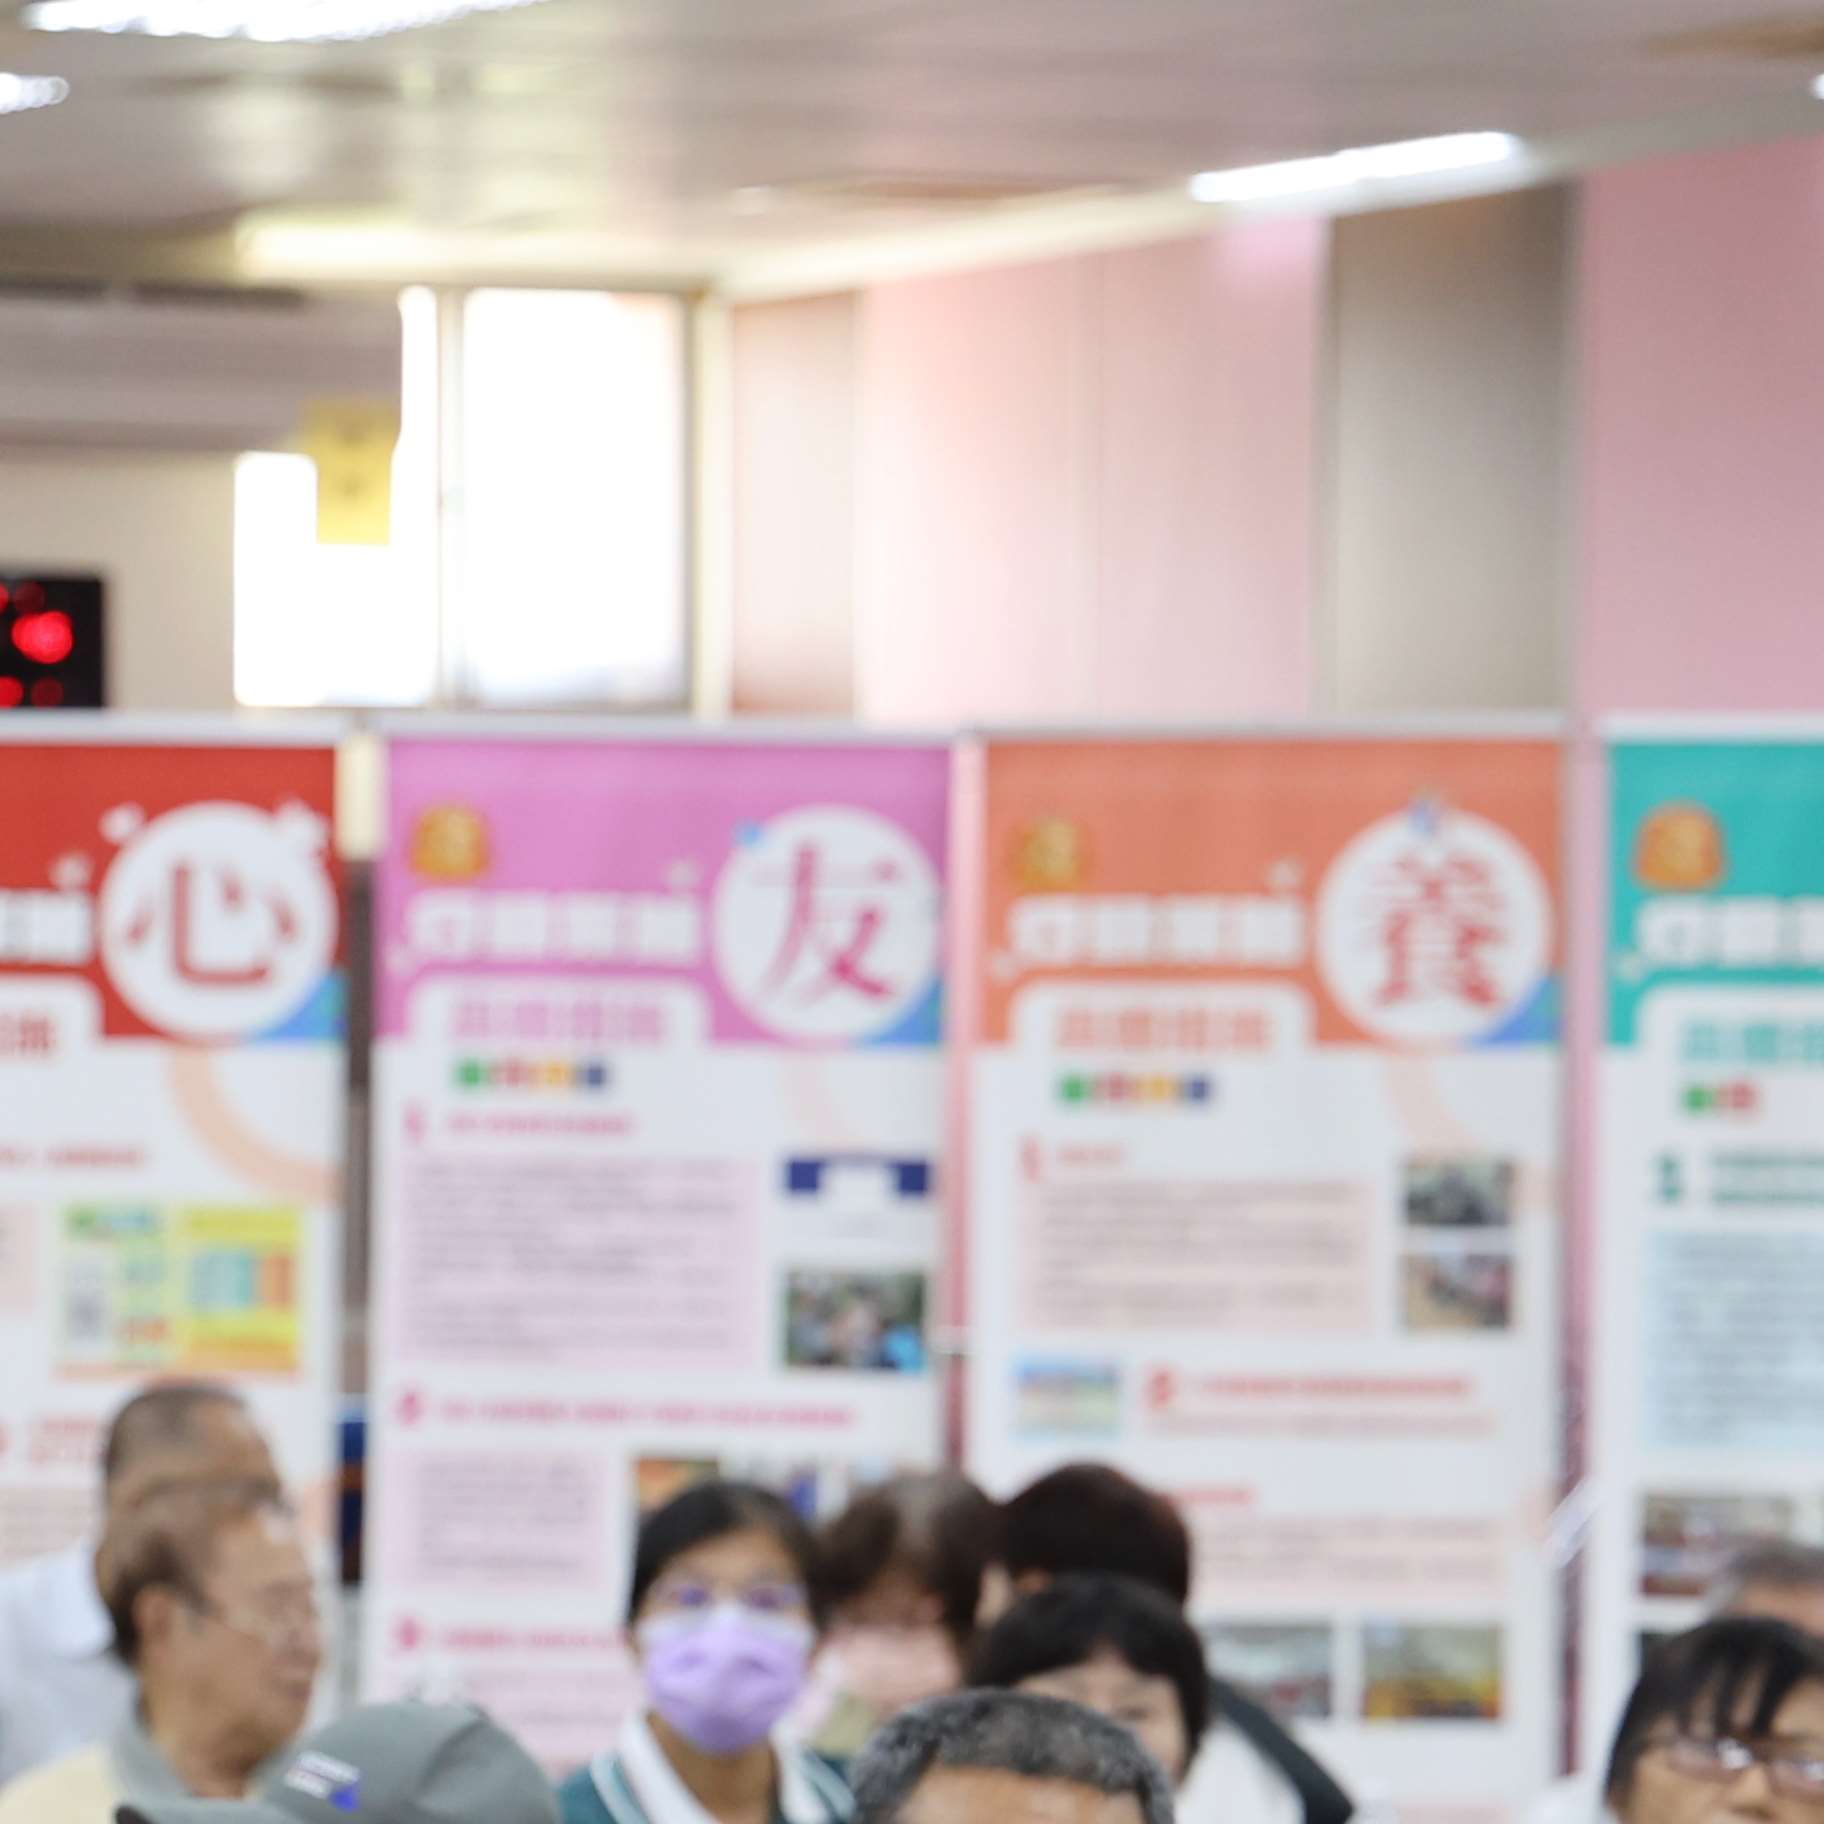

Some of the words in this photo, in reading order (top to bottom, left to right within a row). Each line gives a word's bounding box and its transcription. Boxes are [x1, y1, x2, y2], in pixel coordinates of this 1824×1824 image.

[126, 858, 298, 988] 心
[753, 838, 903, 1005] 友
[1365, 845, 1506, 1017] 養
